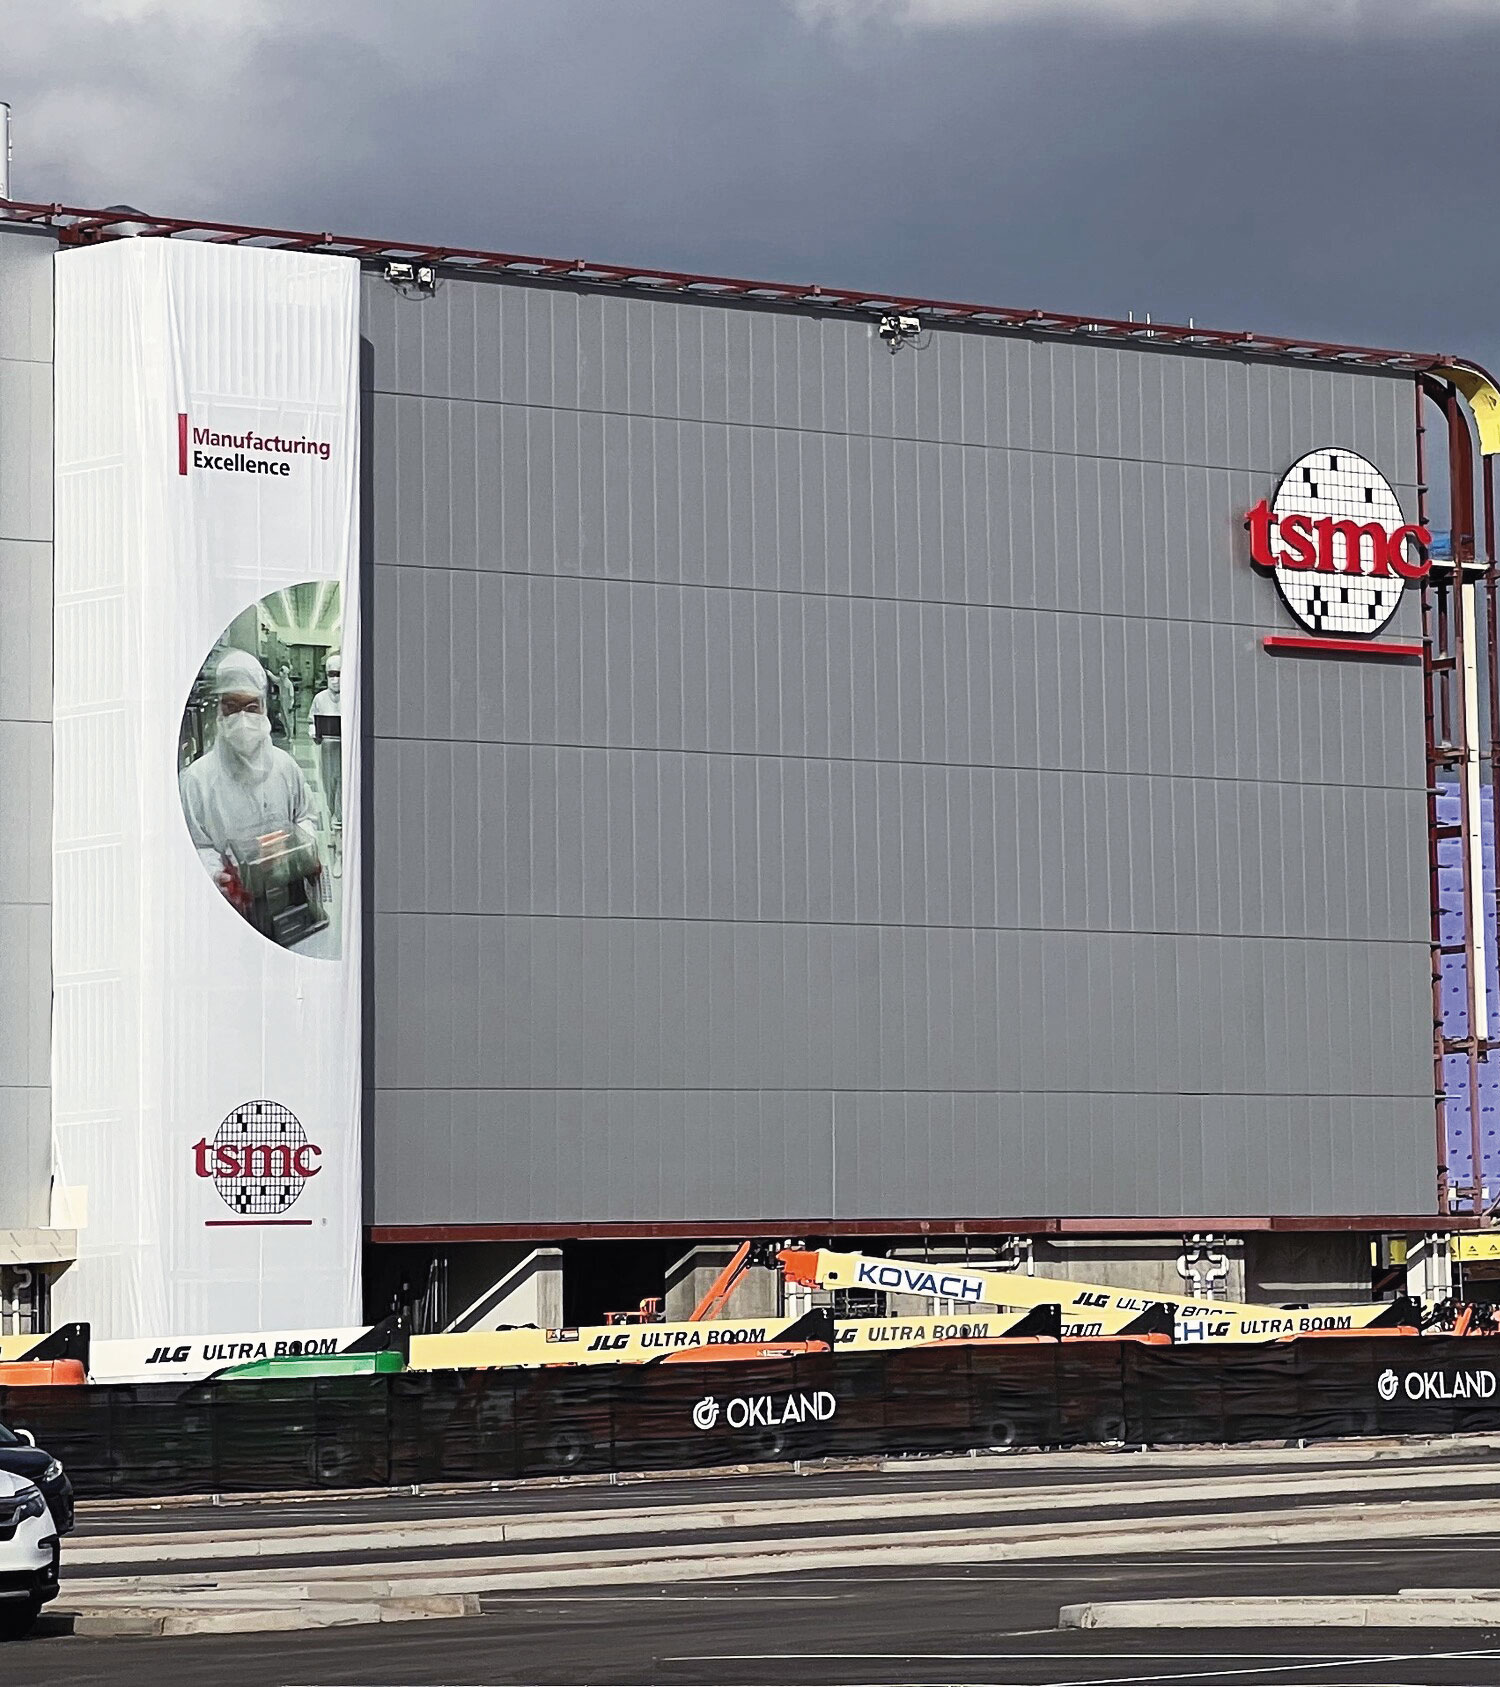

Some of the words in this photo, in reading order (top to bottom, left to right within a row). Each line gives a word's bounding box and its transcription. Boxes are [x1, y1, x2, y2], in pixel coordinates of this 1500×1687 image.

[193, 427, 331, 461] Manufacturing
[193, 450, 291, 477] Excellence
[1245, 499, 1433, 579] tsmc
[191, 1137, 323, 1178] tsmc
[857, 1262, 983, 1300] KOVACH
[1072, 1291, 1111, 1308] JLG
[1115, 1297, 1180, 1313] ULT
[587, 1334, 631, 1351] JLG
[640, 1330, 701, 1348] ULTRA
[707, 1328, 766, 1344] BOOM
[834, 1328, 859, 1343] LG
[868, 1326, 925, 1342] ULTRA
[932, 1322, 989, 1340] BOOM
[1207, 1322, 1231, 1337] LG
[1240, 1318, 1294, 1335] ULTRA
[1300, 1315, 1352, 1331] BOOM
[144, 1345, 192, 1365] JLG
[202, 1342, 267, 1361] ULTRA
[273, 1337, 338, 1357] BOOM
[1404, 1370, 1497, 1400] OKLAND
[726, 1391, 837, 1428] OKLAND
